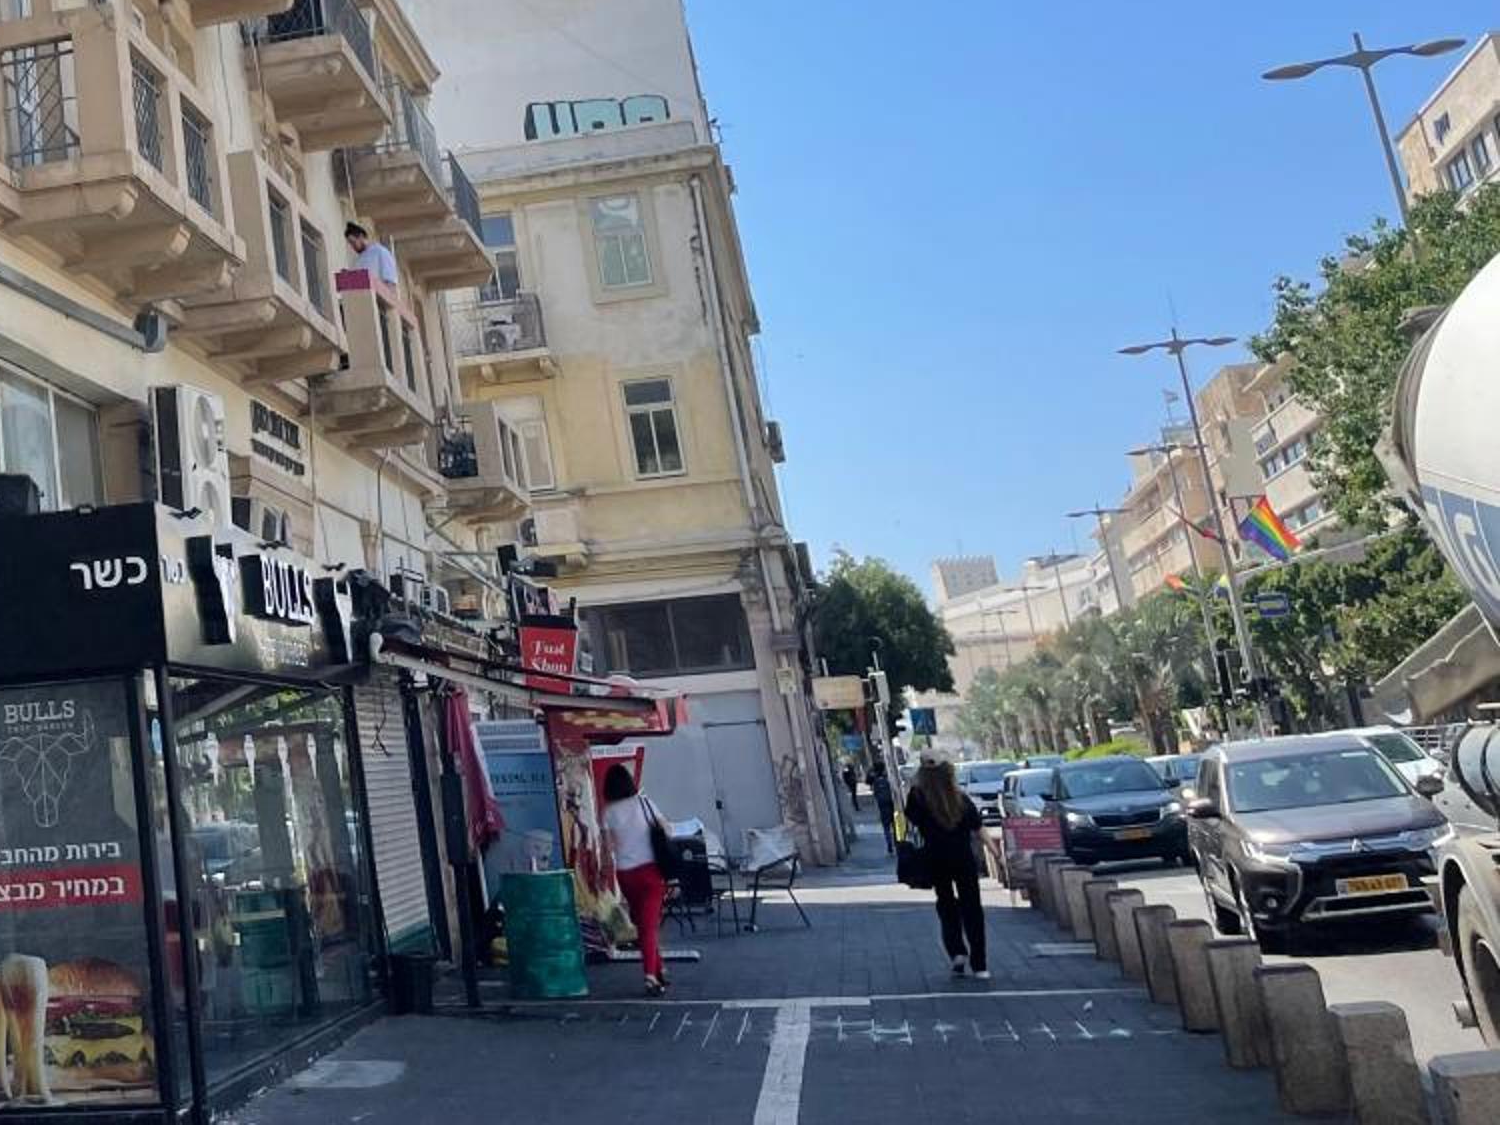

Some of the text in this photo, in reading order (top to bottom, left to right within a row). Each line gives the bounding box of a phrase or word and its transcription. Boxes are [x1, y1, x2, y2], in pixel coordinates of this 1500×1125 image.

[70, 556, 148, 590] כשר
[259, 554, 317, 625] BULLS
[4, 700, 76, 724] BULLS
[65, 842, 121, 860] בירות
[51, 876, 125, 898] במחיר
